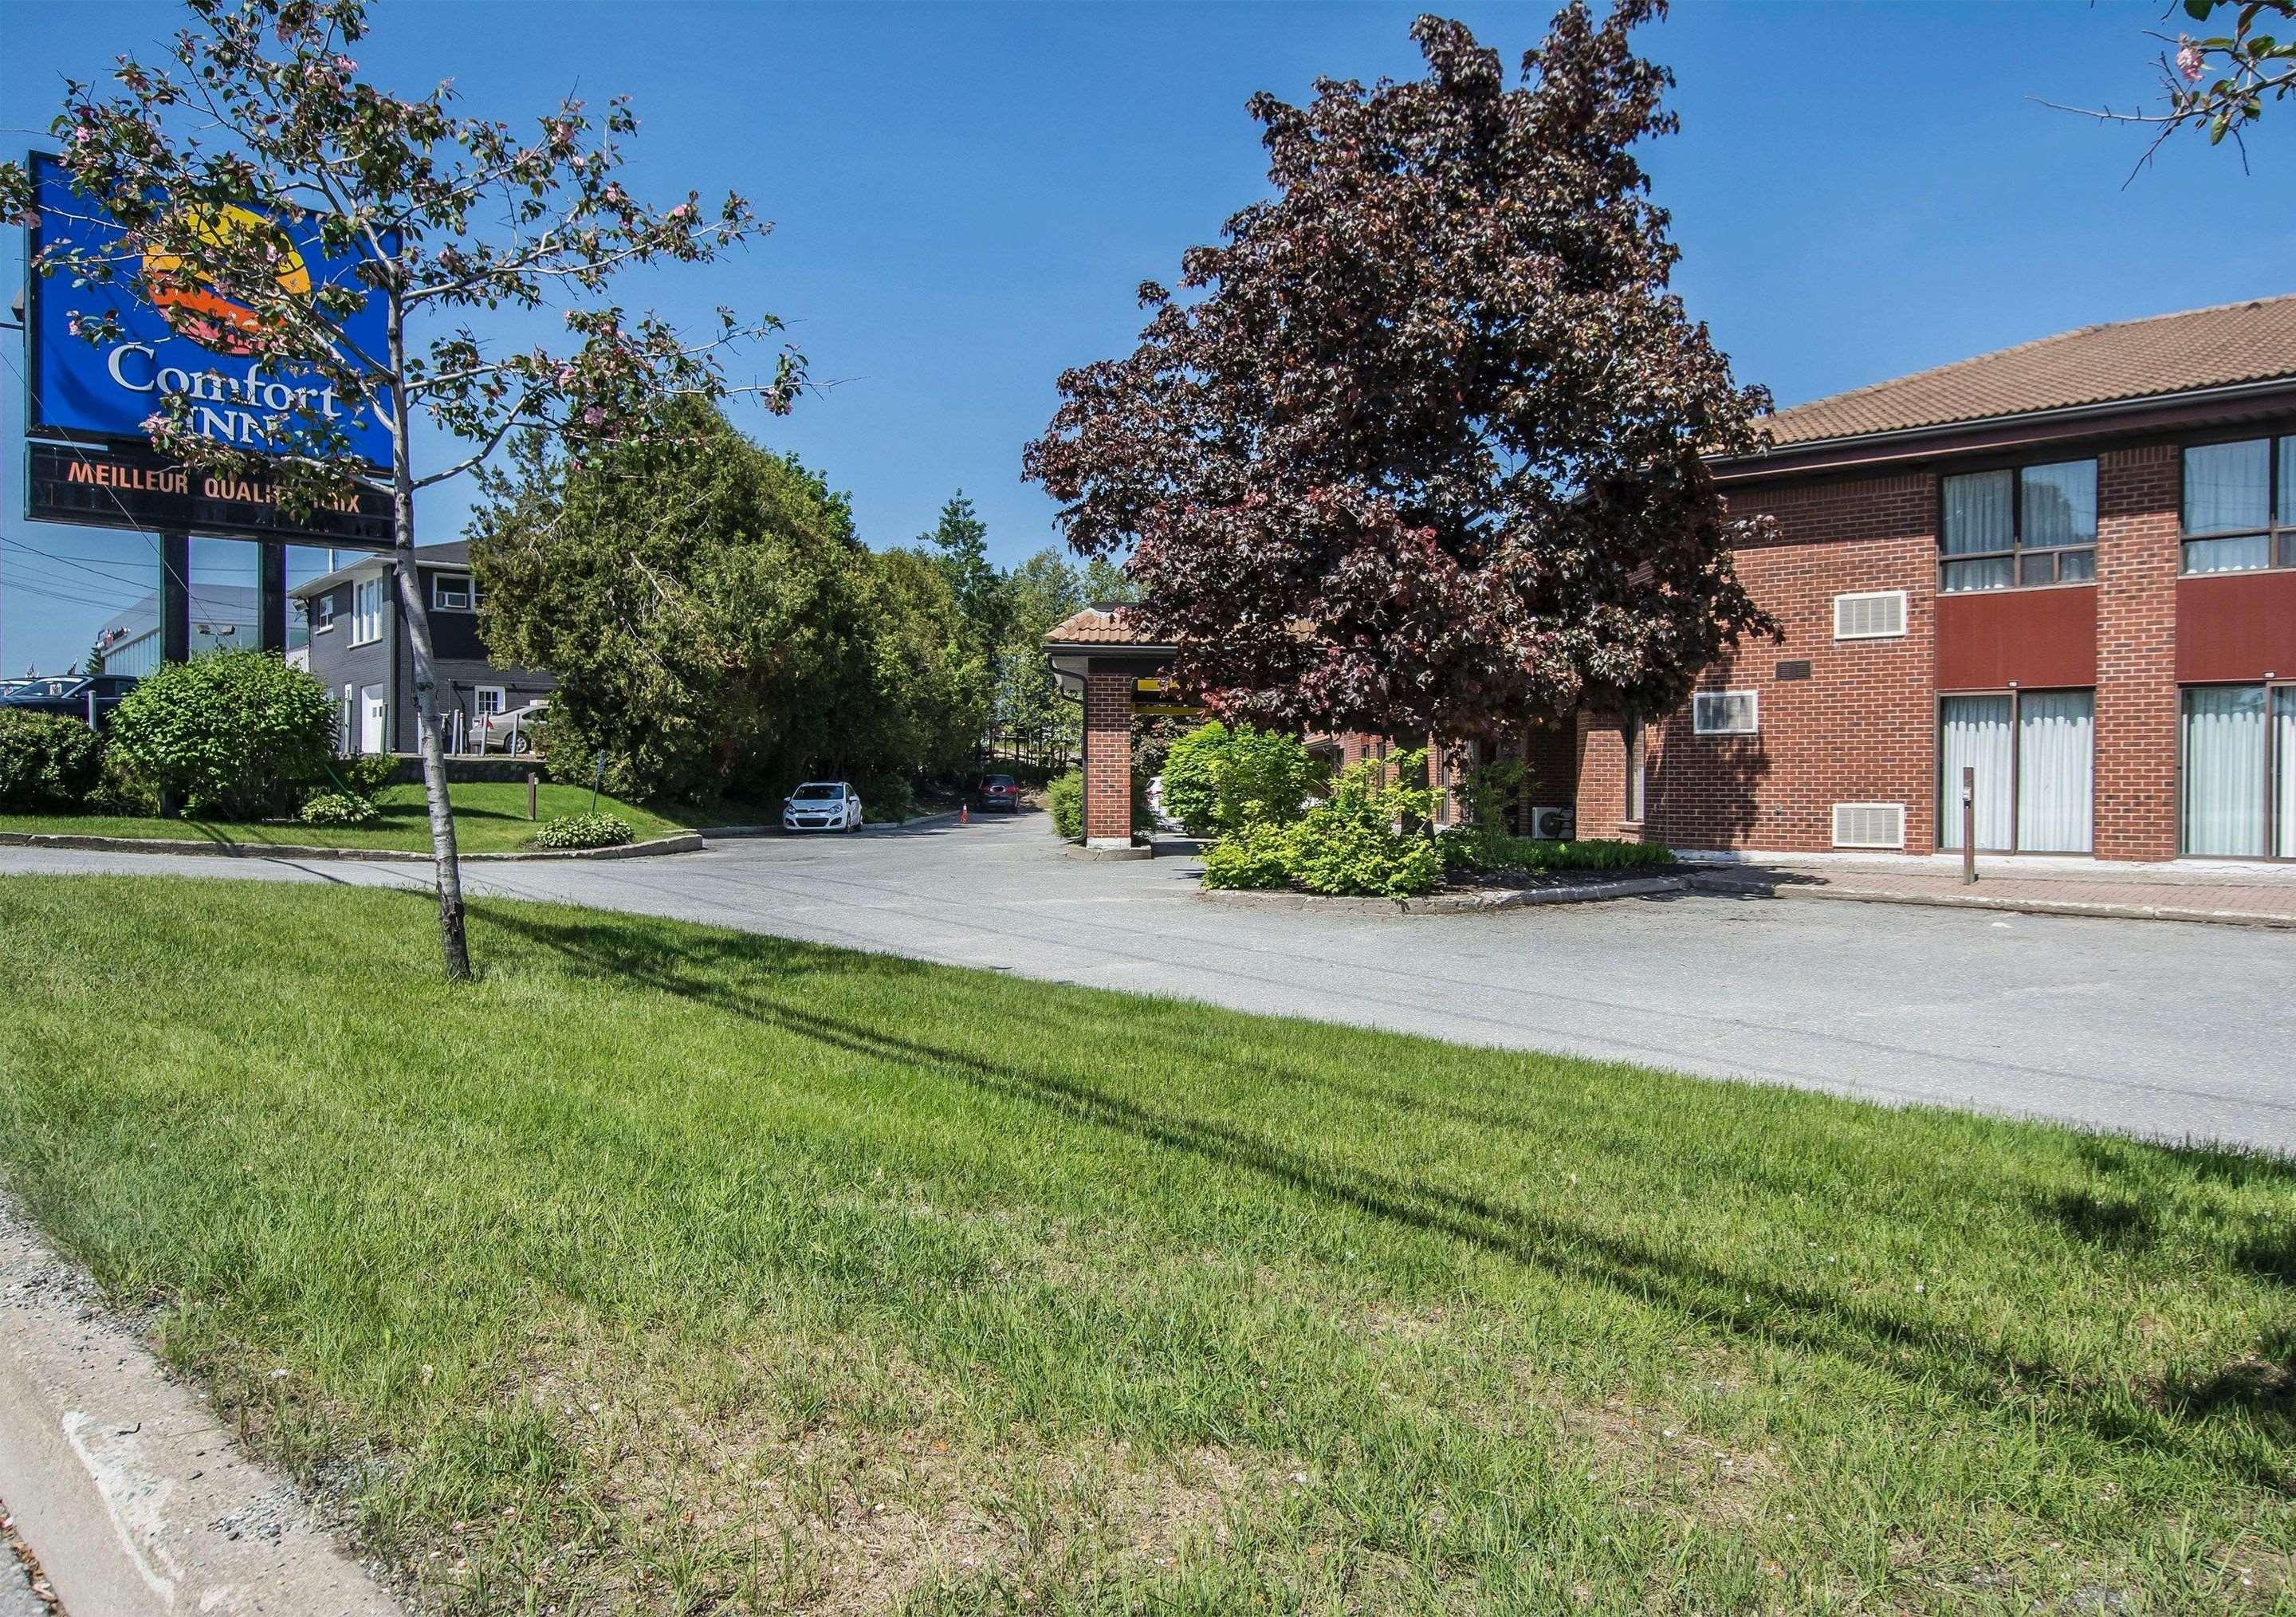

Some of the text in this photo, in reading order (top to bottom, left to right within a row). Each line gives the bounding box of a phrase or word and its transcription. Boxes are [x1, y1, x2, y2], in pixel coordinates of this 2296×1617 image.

[108, 344, 342, 417] Comfort
[185, 406, 278, 447] INN
[68, 462, 188, 494] MEILLEUR
